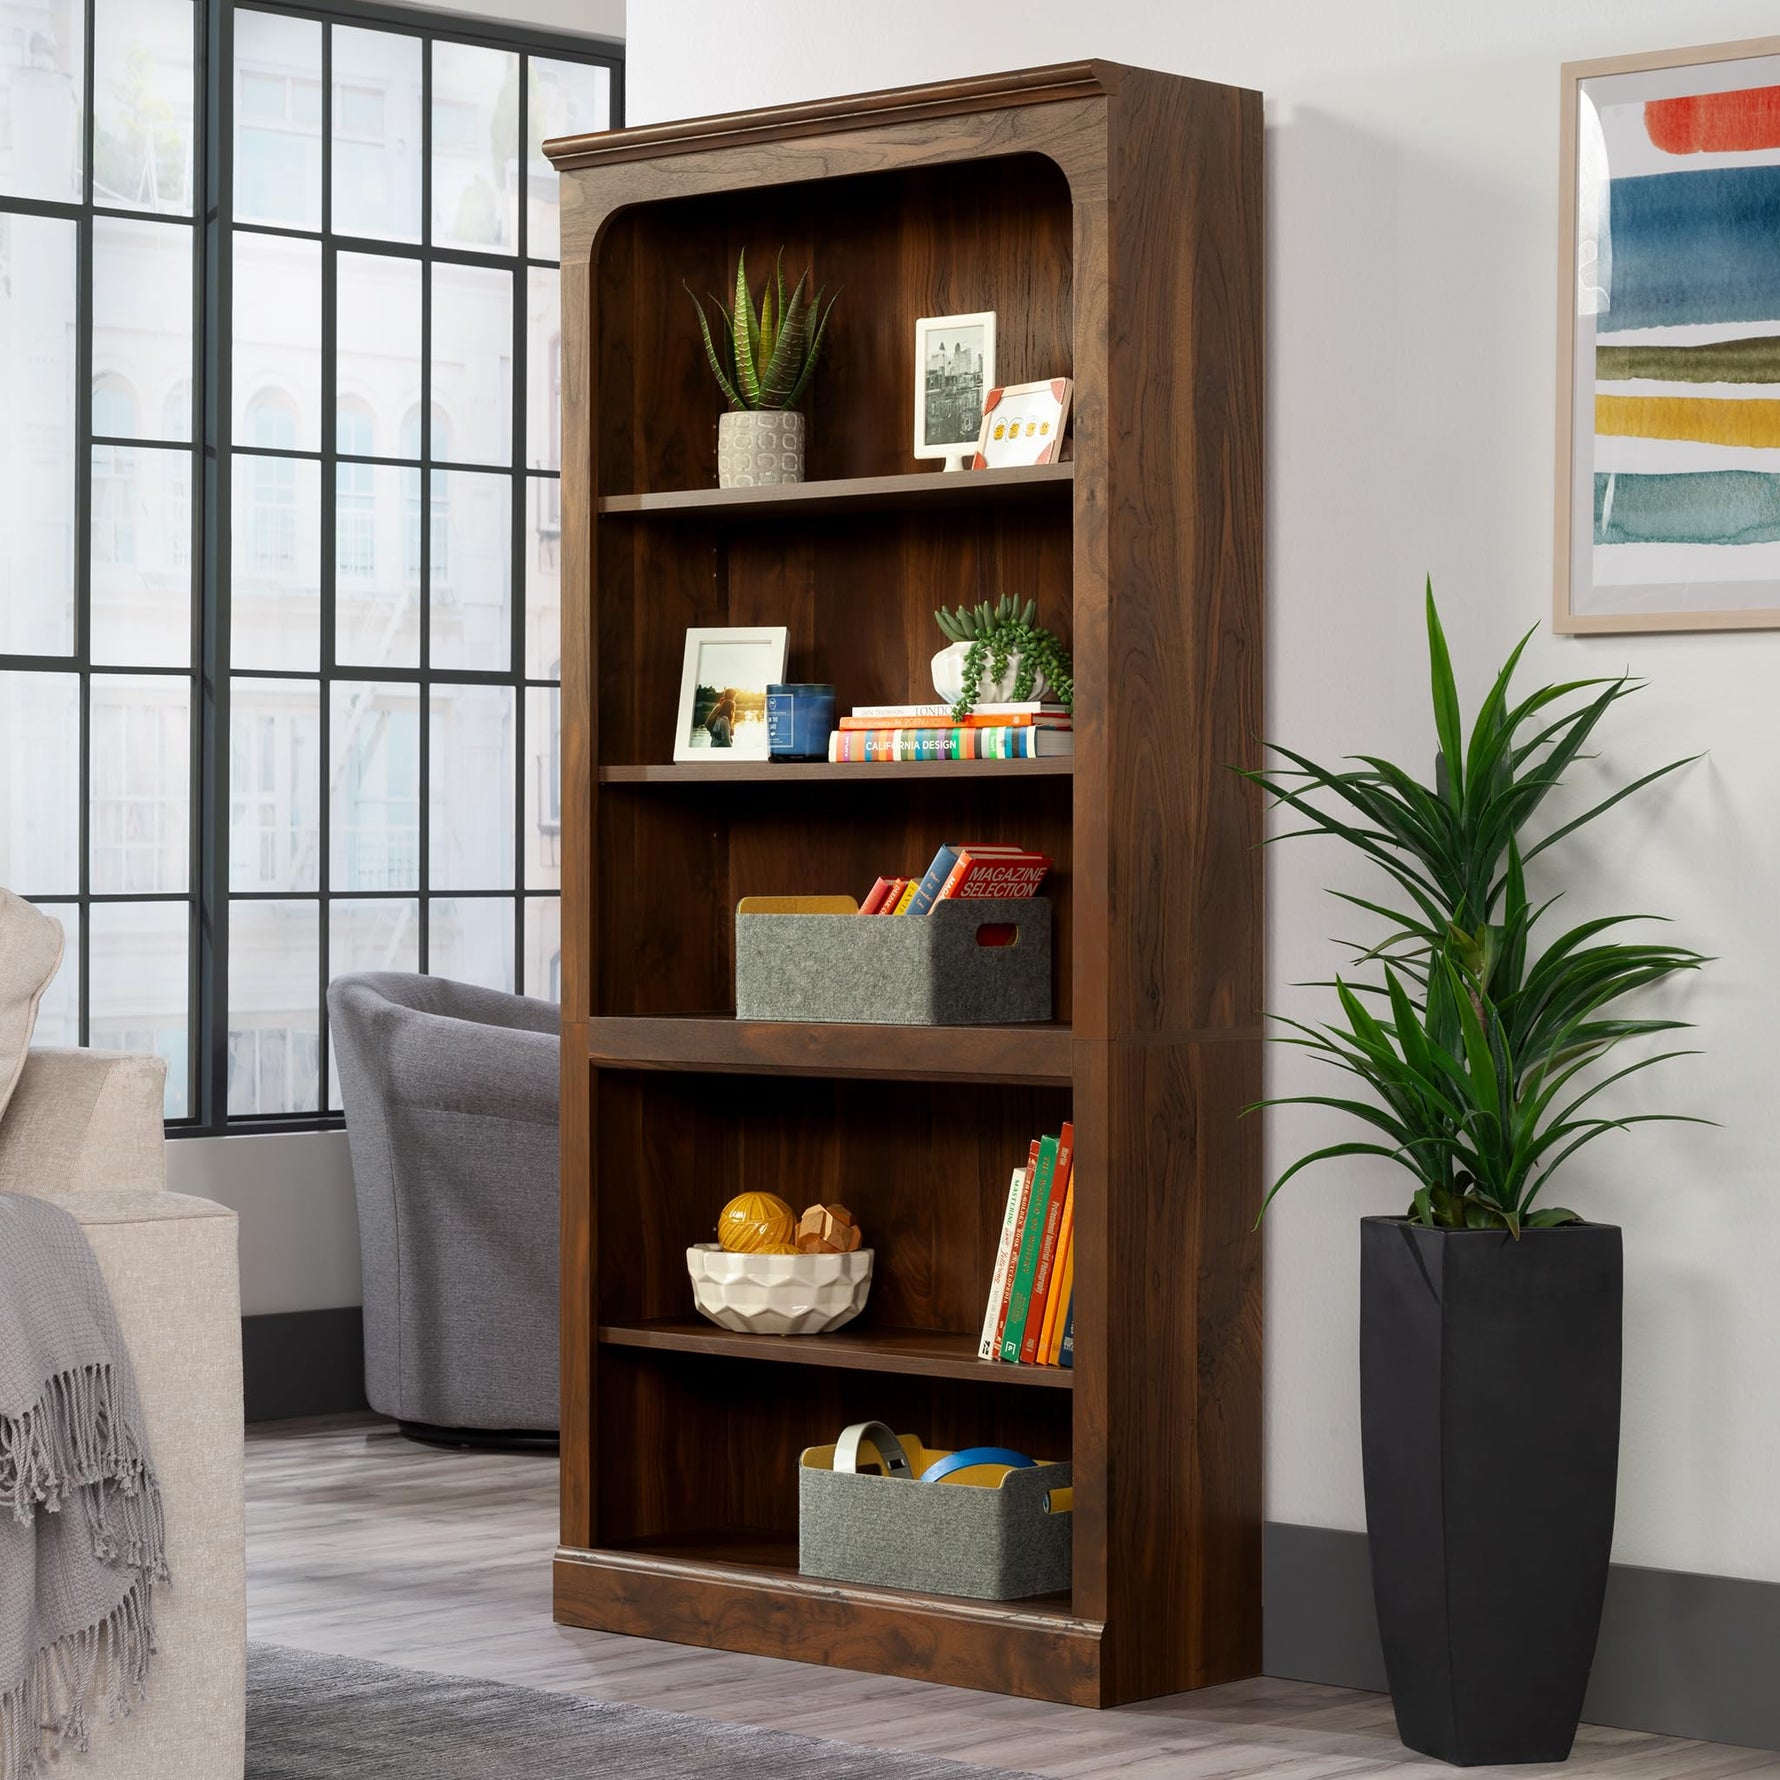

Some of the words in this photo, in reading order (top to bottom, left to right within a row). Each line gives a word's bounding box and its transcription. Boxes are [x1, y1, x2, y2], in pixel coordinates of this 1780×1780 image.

[865, 739, 920, 751] CALIFORNIA
[922, 739, 957, 750] DESIGN
[968, 866, 1048, 881] MAGAZINE
[940, 875, 956, 899] MAGA
[960, 882, 1039, 897] SELECTION
[1019, 1196, 1027, 1224] GOLDEN
[1003, 1251, 1017, 1304] ENCYCLOPEDIA
